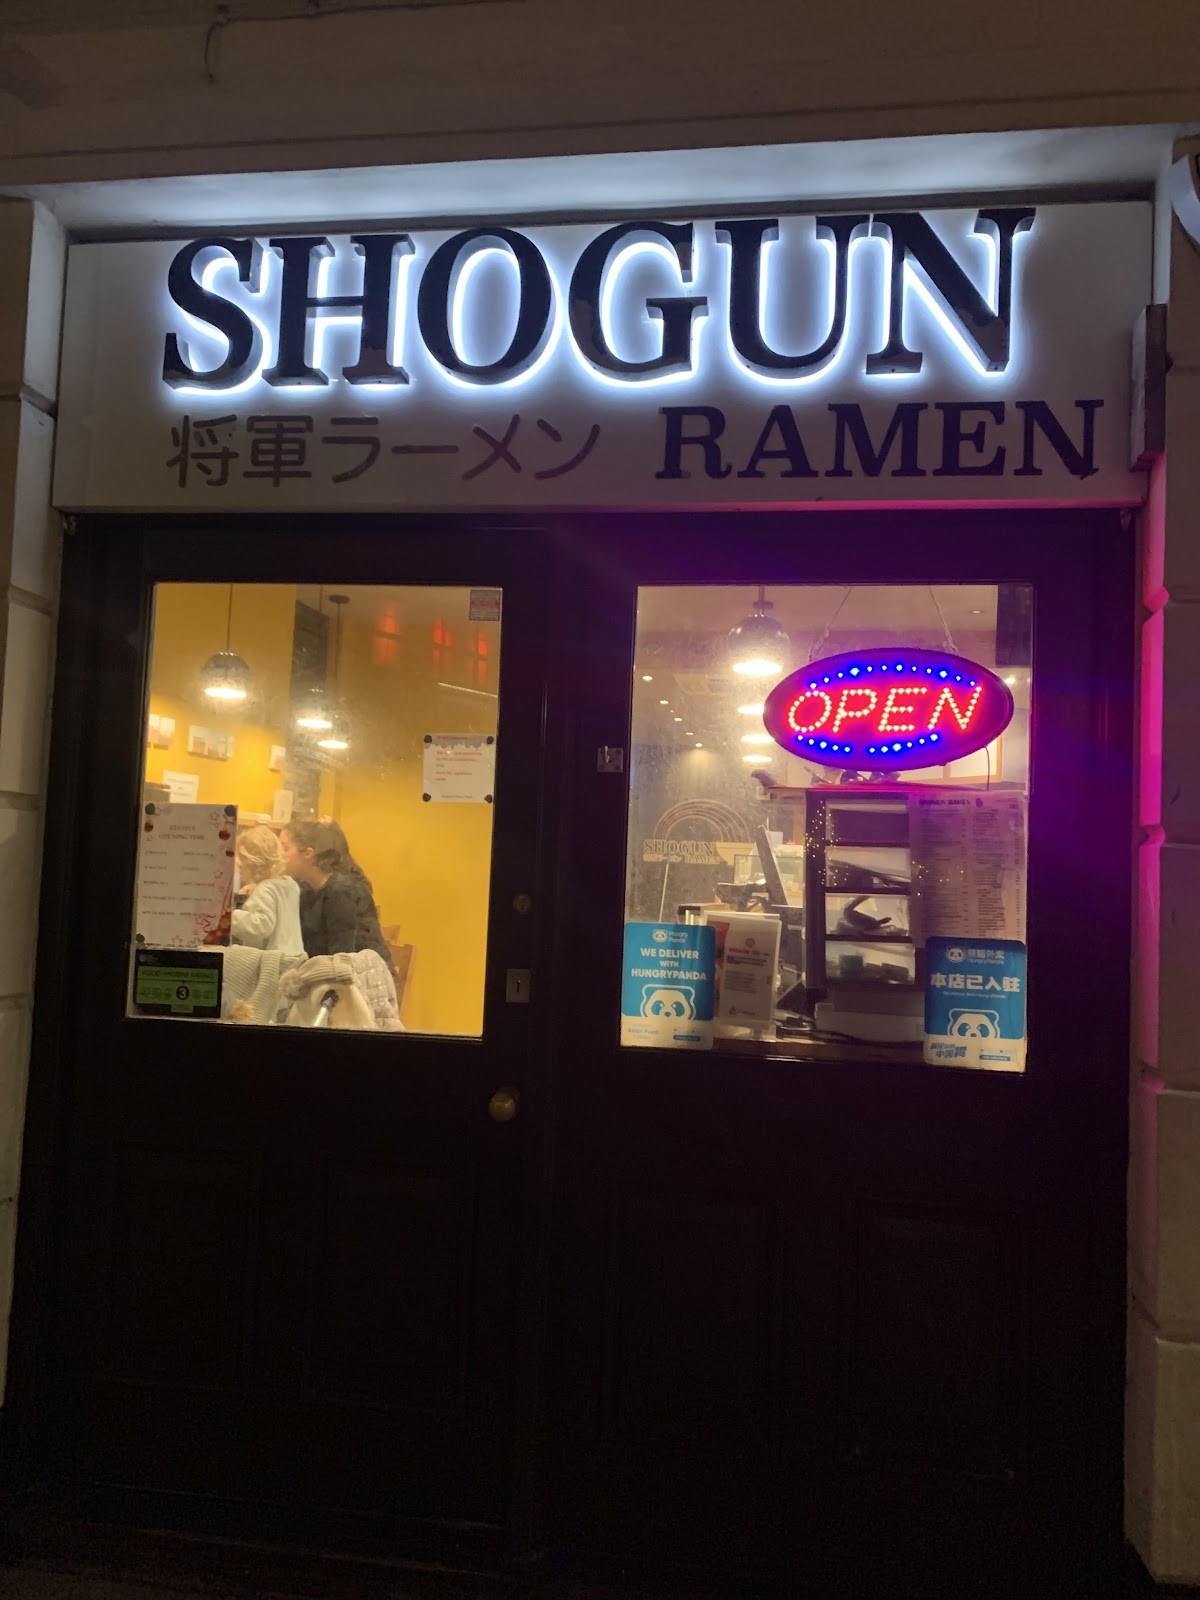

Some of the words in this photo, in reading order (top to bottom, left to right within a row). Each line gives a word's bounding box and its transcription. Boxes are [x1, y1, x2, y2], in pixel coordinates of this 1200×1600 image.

[162, 207, 1036, 388] SHOGUN
[655, 400, 1105, 480] RAMEN
[167, 413, 600, 488] 将軍ラーメン
[787, 685, 984, 734] OPEN
[643, 838, 715, 856] SHOGUN
[640, 948, 657, 957] WE
[658, 949, 699, 959] DELIVER
[659, 960, 679, 968] WITH
[631, 968, 707, 981] HUNGRYPANDA
[179, 987, 187, 1000] 3
